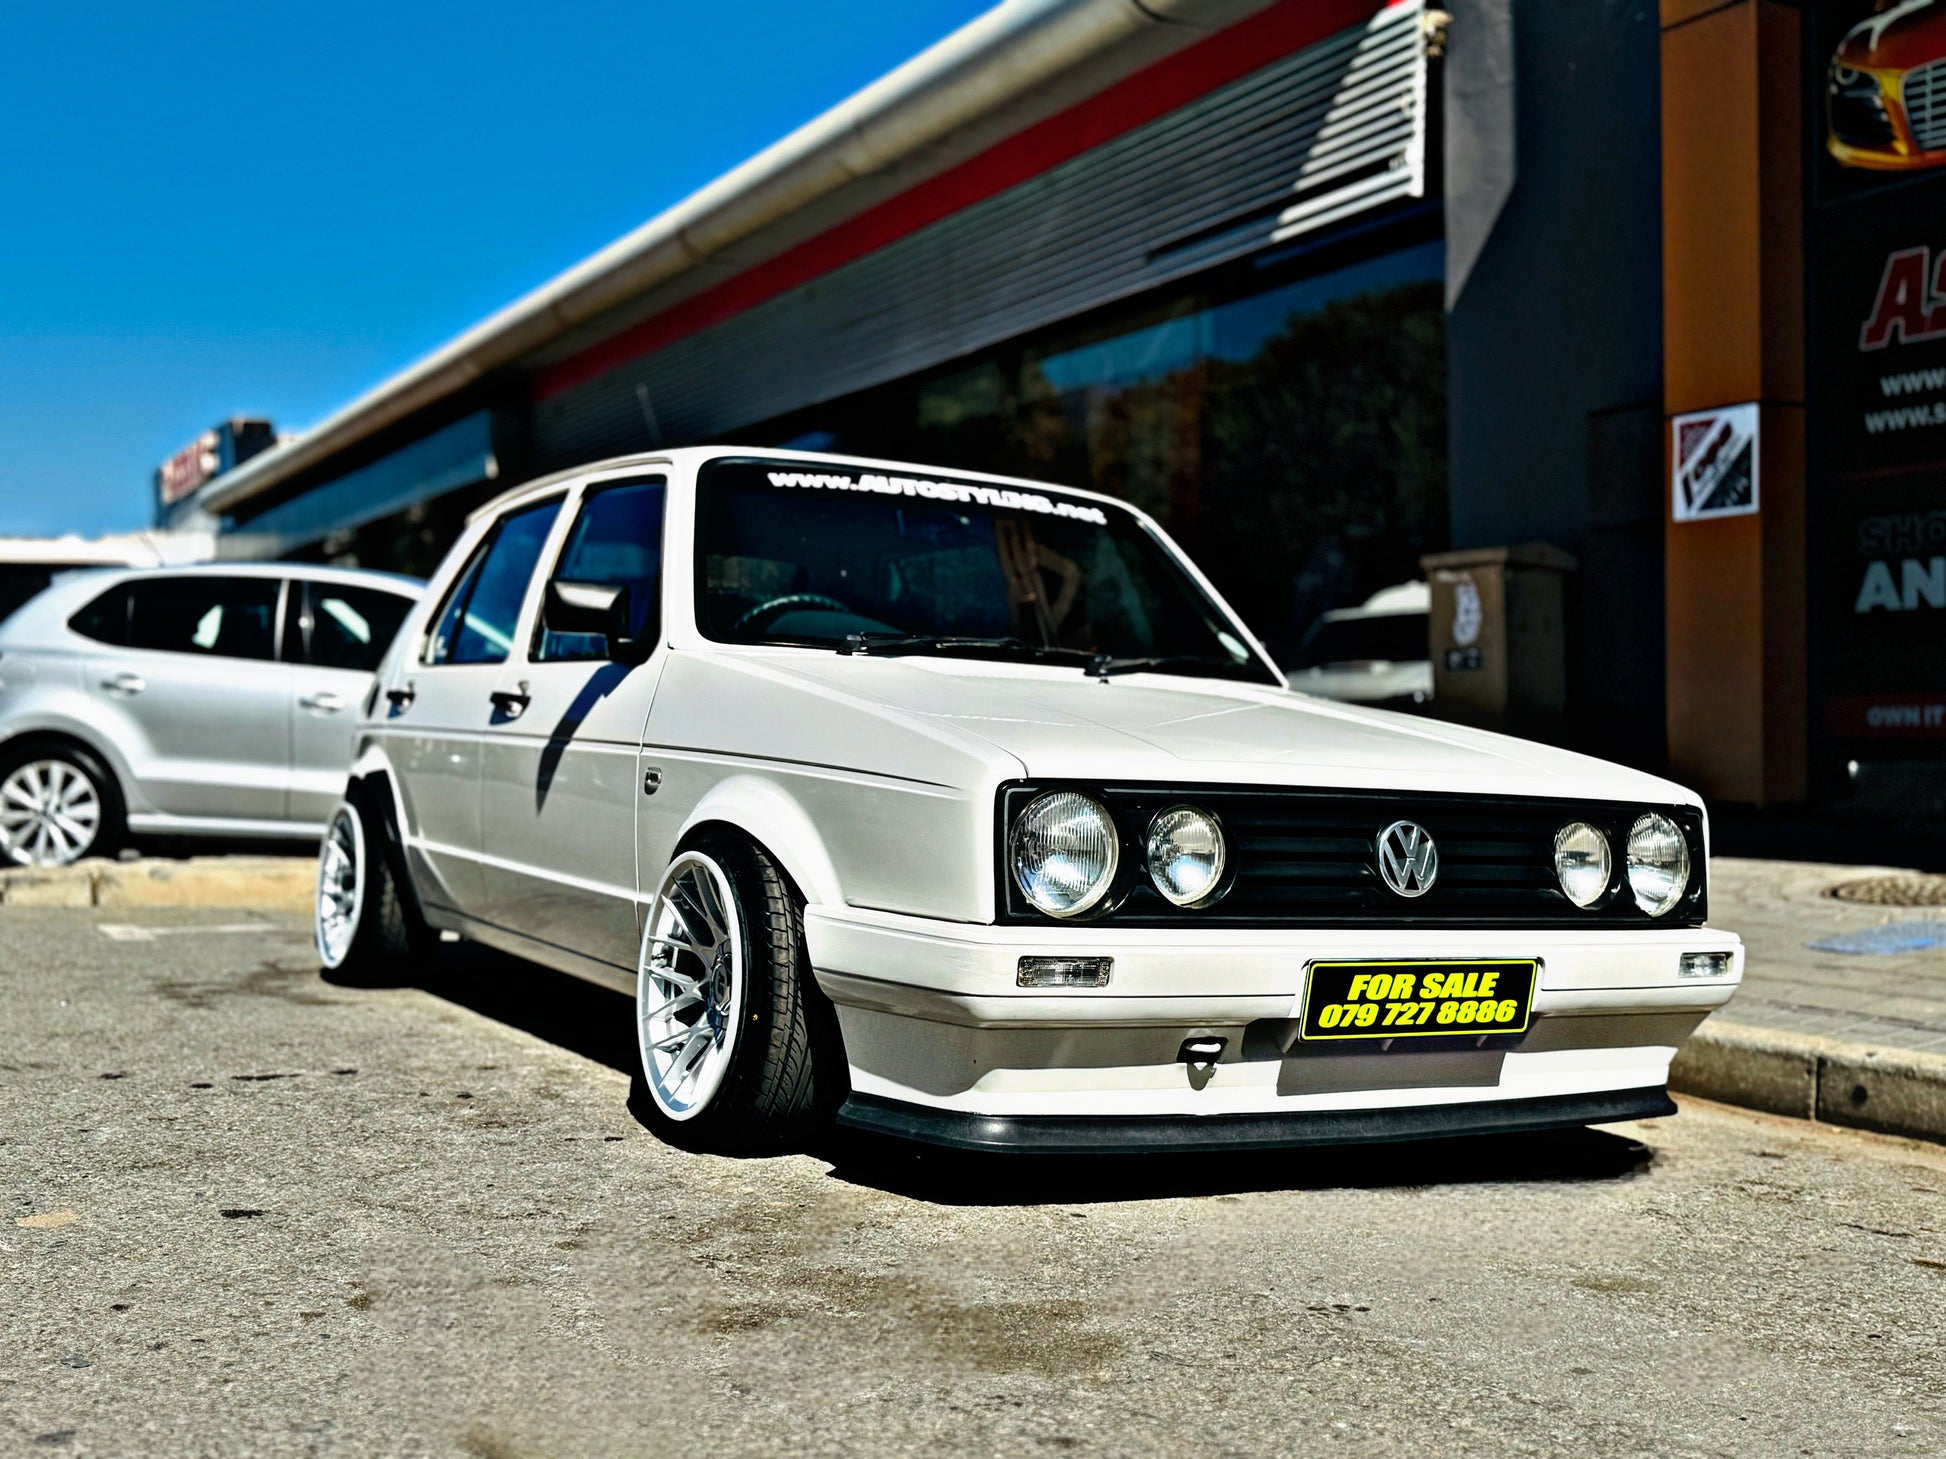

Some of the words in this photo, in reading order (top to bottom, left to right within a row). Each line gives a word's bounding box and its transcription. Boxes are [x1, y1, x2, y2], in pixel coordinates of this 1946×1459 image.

[767, 472, 1107, 525] www.AUTOSTYLING.net
[1347, 973, 1416, 1001] FOR
[1419, 972, 1500, 999] SALE
[1318, 1003, 1380, 1028] 079
[1382, 1002, 1436, 1026] 727
[1436, 999, 1518, 1024] 8886
